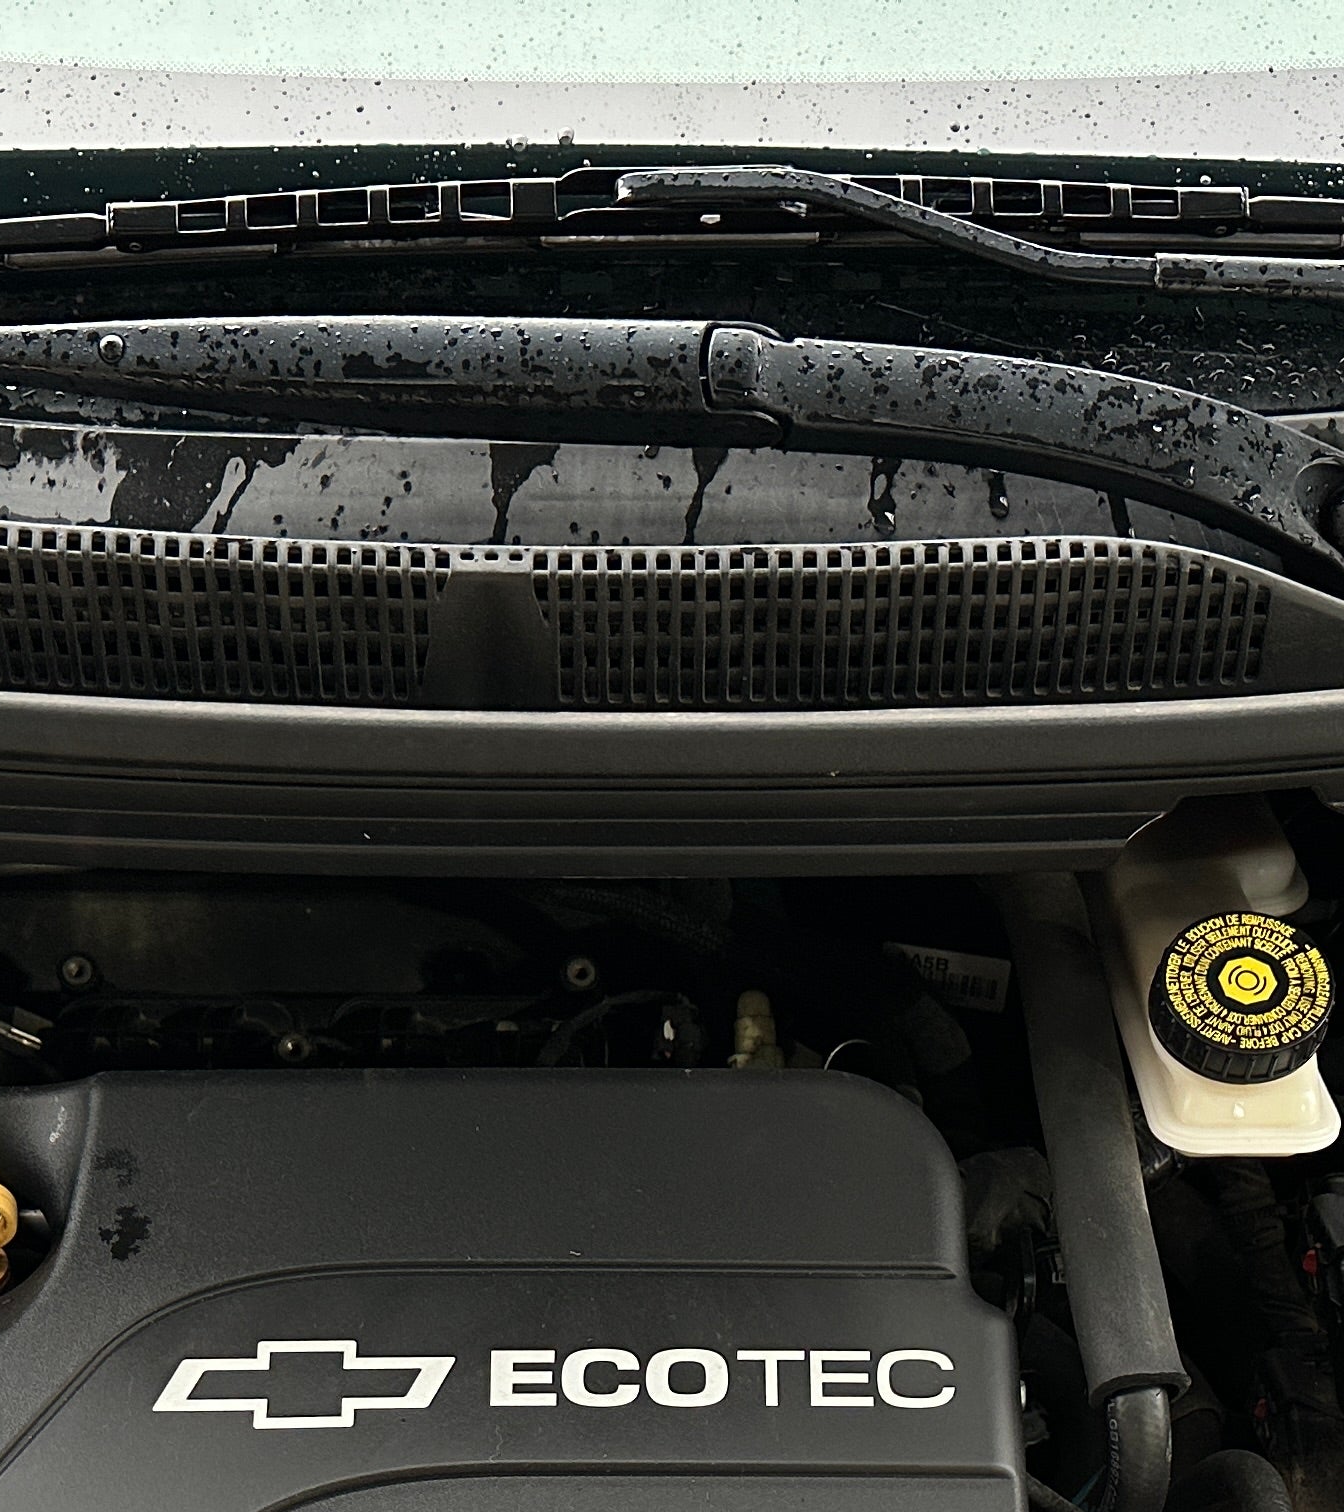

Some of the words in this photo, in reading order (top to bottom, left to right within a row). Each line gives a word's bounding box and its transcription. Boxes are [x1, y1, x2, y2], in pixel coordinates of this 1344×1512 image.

[1174, 938, 1191, 952] LE
[1184, 916, 1224, 941] BOUCHON
[1225, 914, 1240, 925] DE
[1280, 958, 1300, 977] FROM
[1192, 1003, 1208, 1016] DE
[1295, 995, 1314, 1013] USE
[1204, 1014, 1234, 1033] AVANT
[1239, 1034, 1281, 1049] BEFORE
[1281, 1026, 1303, 1044] CAP
[488, 1347, 958, 1410] ECOTEC
